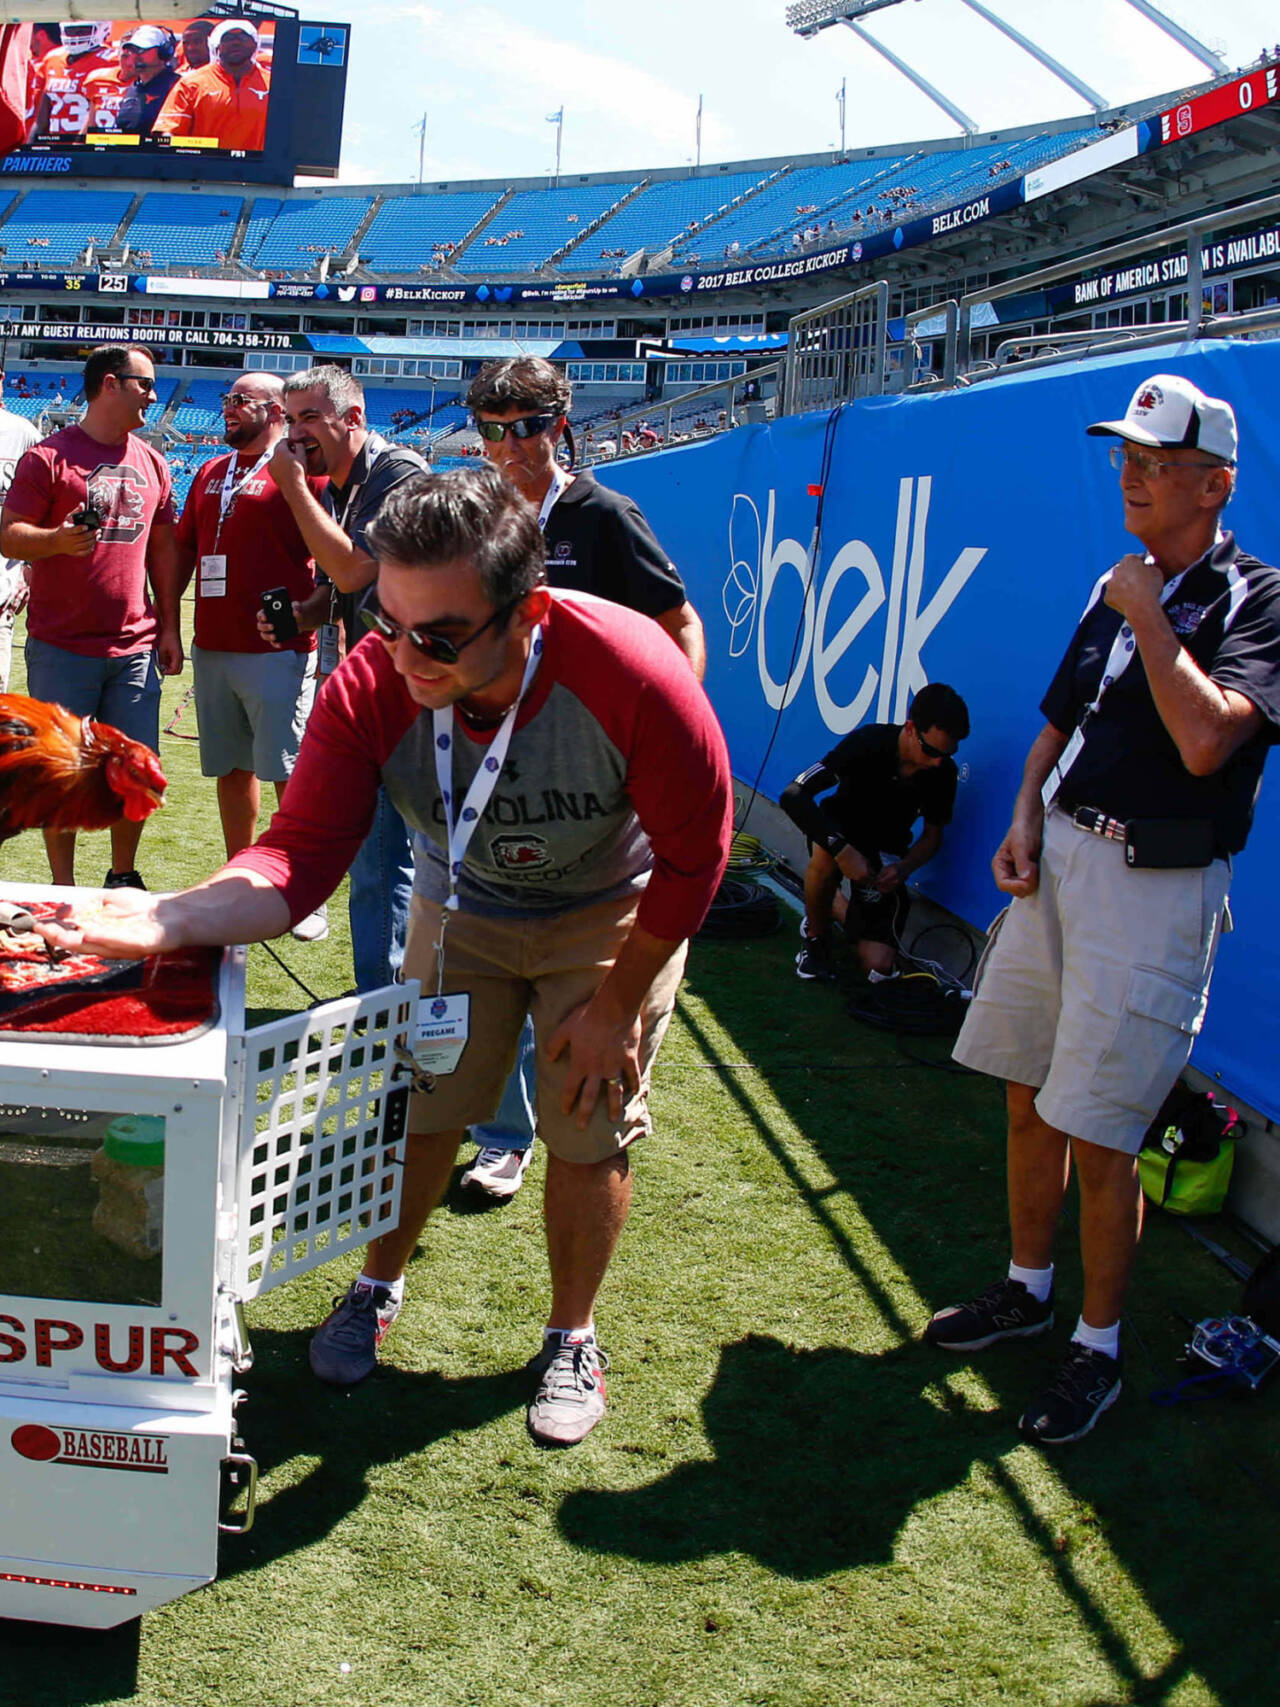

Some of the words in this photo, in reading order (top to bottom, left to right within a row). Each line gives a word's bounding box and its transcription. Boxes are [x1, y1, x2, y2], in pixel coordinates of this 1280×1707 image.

[1239, 82, 1252, 109] 0
[2, 157, 72, 173] PANTHERS
[932, 197, 990, 235] BELK.COM
[698, 274, 724, 289] 2017
[725, 269, 753, 287] BELK
[754, 262, 805, 282] COLLEGE
[805, 248, 849, 273] KICKOFF
[1075, 281, 1099, 304] BANK
[1100, 276, 1113, 297] OF
[1115, 263, 1160, 293] AMERICA
[1161, 246, 1209, 282] STADM
[1212, 245, 1224, 268] IS
[65, 280, 81, 290] 35
[103, 277, 124, 290] 25
[21, 325, 40, 337] ANY
[43, 326, 75, 338] GUEST
[77, 327, 129, 340] RELATIONS
[132, 329, 166, 342] BOOTH
[169, 330, 182, 343] OR
[186, 331, 210, 344] CALL
[758, 475, 989, 735] belk
[421, 1028, 455, 1038] PREGAME
[63, 1430, 167, 1465] BASEBALL
